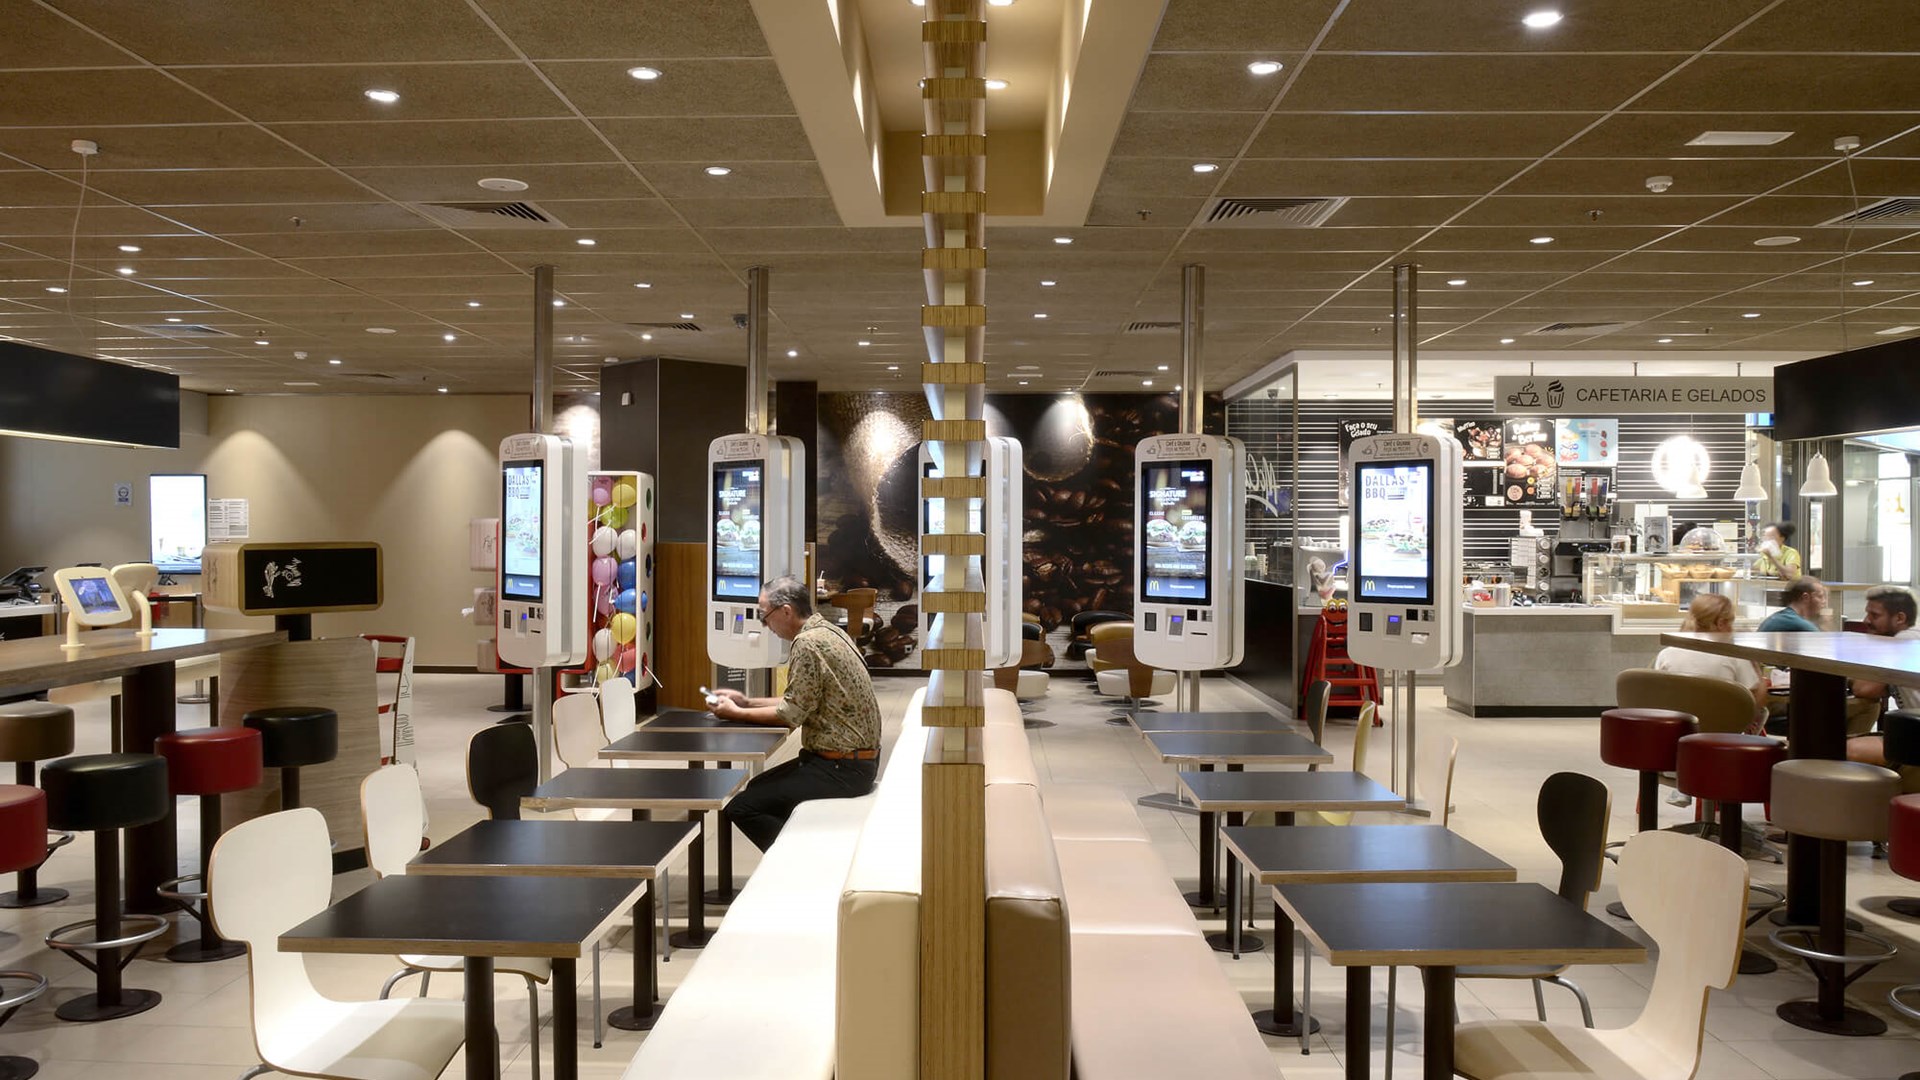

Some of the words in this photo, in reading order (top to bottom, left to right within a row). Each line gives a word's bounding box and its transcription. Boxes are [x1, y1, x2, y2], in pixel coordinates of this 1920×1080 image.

[1576, 388, 1668, 403] CAFETARIA
[1672, 388, 1682, 402] E
[1687, 388, 1767, 403] GELADOS
[1365, 475, 1405, 487] DALLAS
[1365, 487, 1386, 500] BBQ
